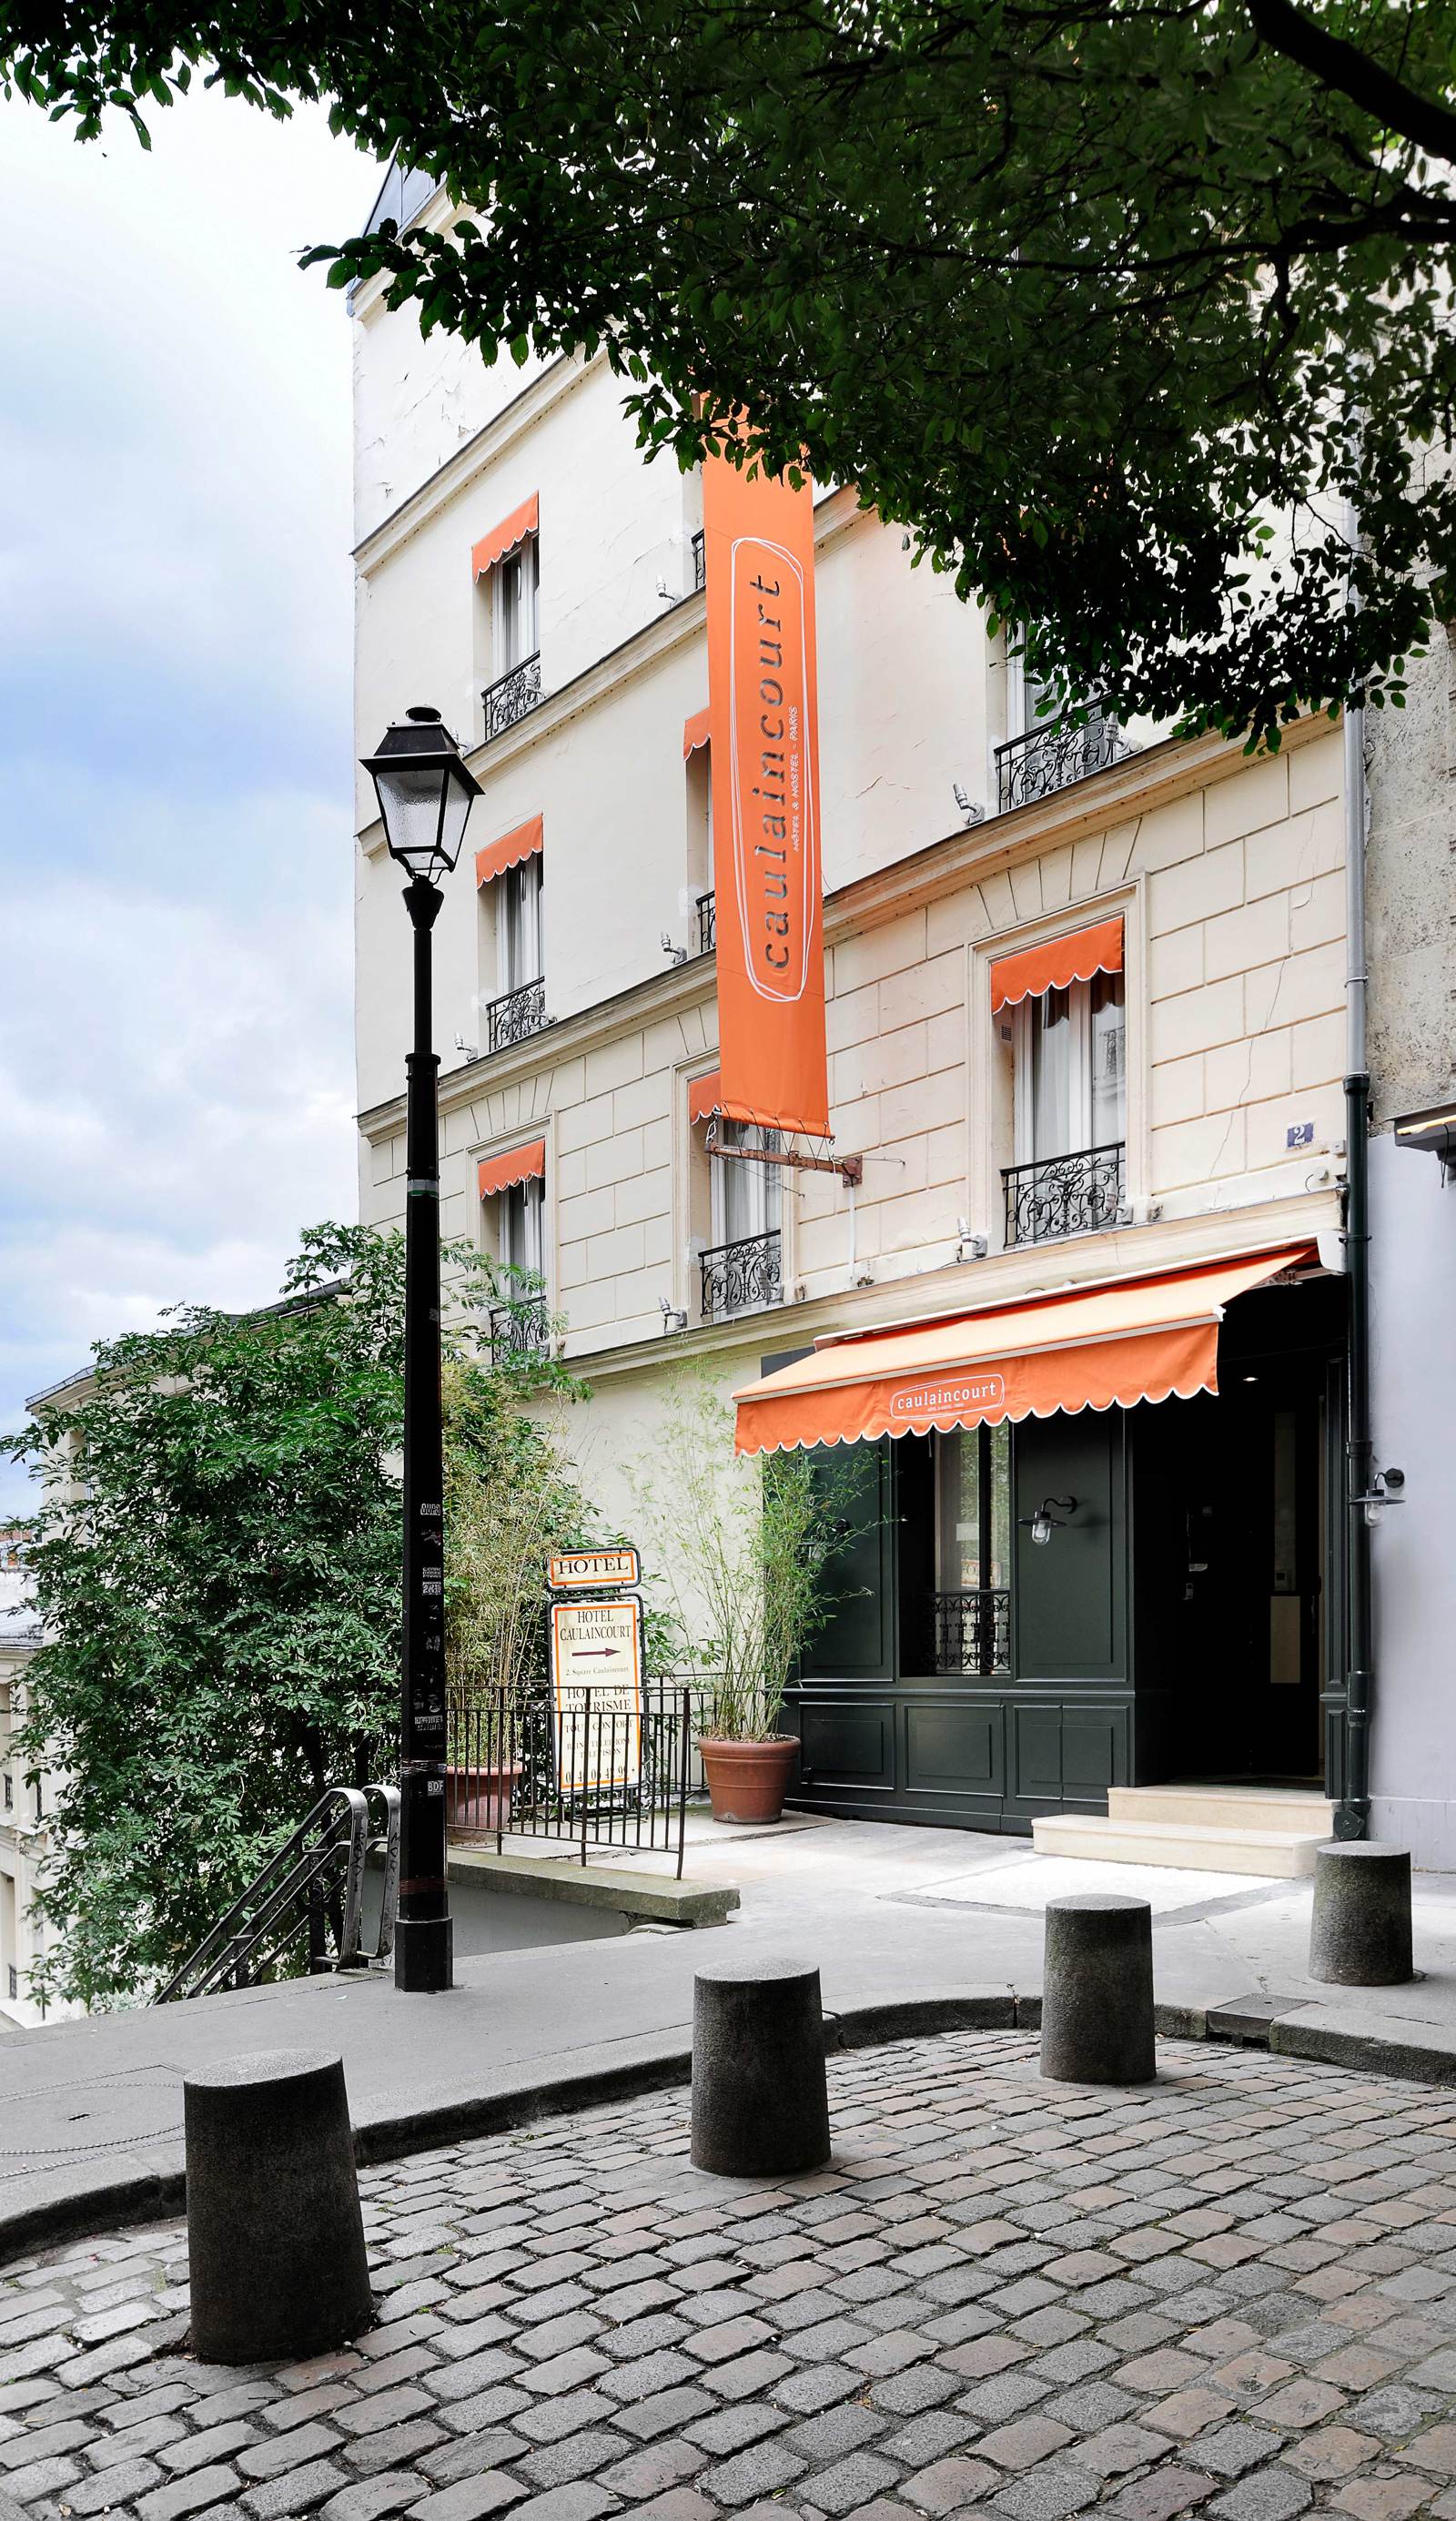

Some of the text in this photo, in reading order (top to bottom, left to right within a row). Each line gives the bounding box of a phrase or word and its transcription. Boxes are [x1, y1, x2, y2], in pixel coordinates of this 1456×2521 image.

[788, 705, 799, 742] PARIS
[750, 575, 789, 968] caulaincourt
[1294, 1126, 1305, 1145] 2
[897, 1382, 996, 1410] caulaincourt
[559, 1557, 629, 1574] HOTEL
[577, 1610, 613, 1624] HOTEL
[560, 1625, 632, 1641] CAULAINCOURT
[613, 1685, 630, 1696] DE
